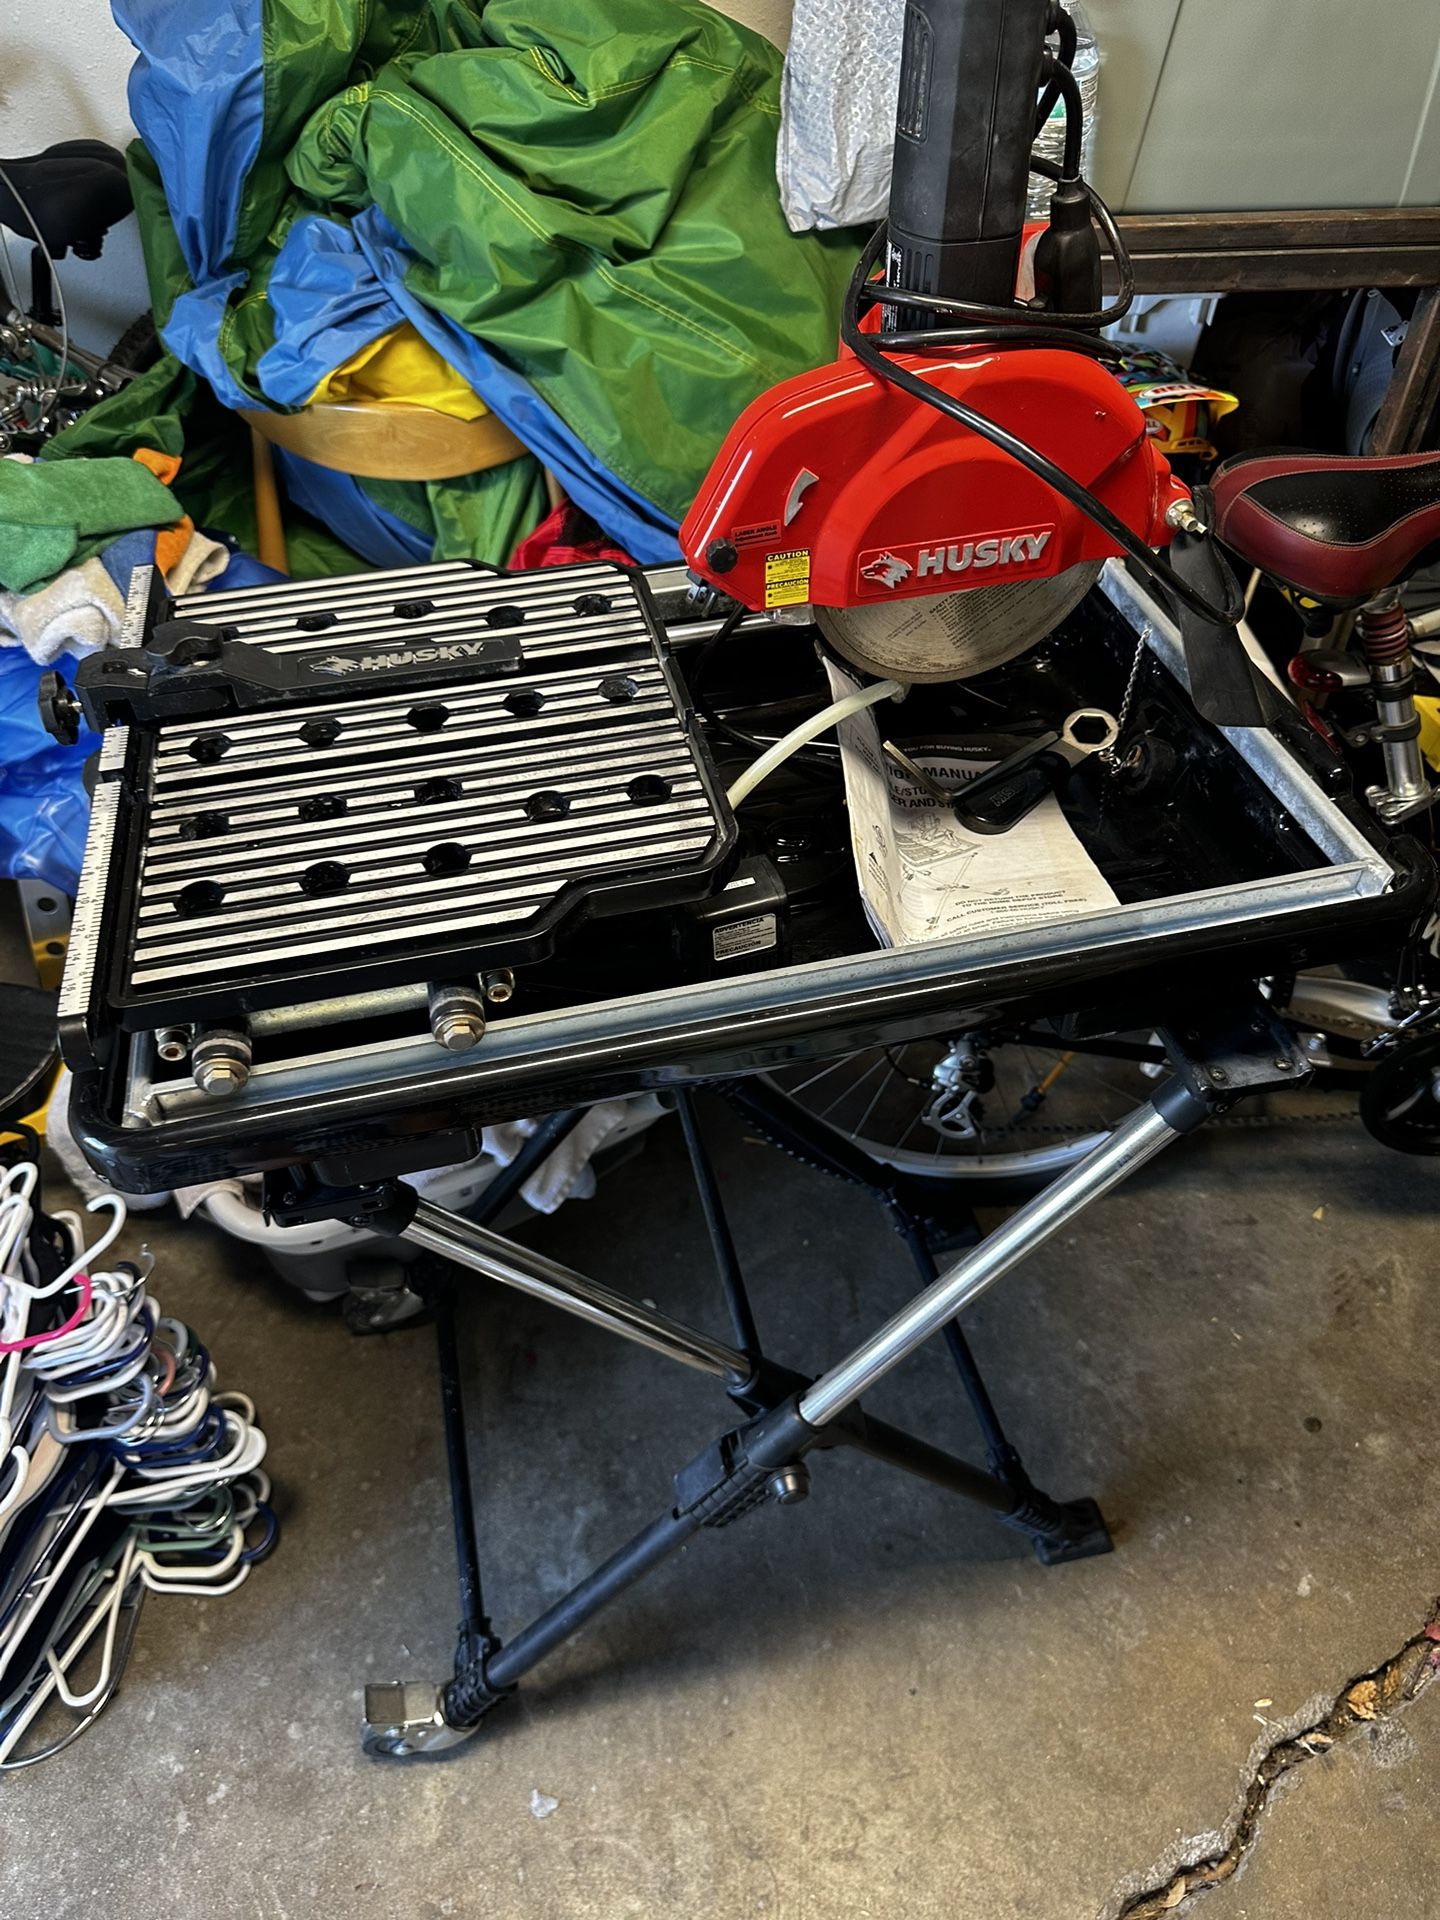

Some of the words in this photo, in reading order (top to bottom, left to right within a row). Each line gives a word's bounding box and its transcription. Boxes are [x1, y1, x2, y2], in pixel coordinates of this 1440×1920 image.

[767, 550, 809, 562] CAUTION
[917, 531, 1051, 577] HUSKY
[360, 642, 484, 671] HUSKY
[923, 767, 982, 781] MANUA
[909, 797, 936, 808] AND
[947, 914, 965, 922] CALL
[966, 905, 1007, 915] CUSTOMER
